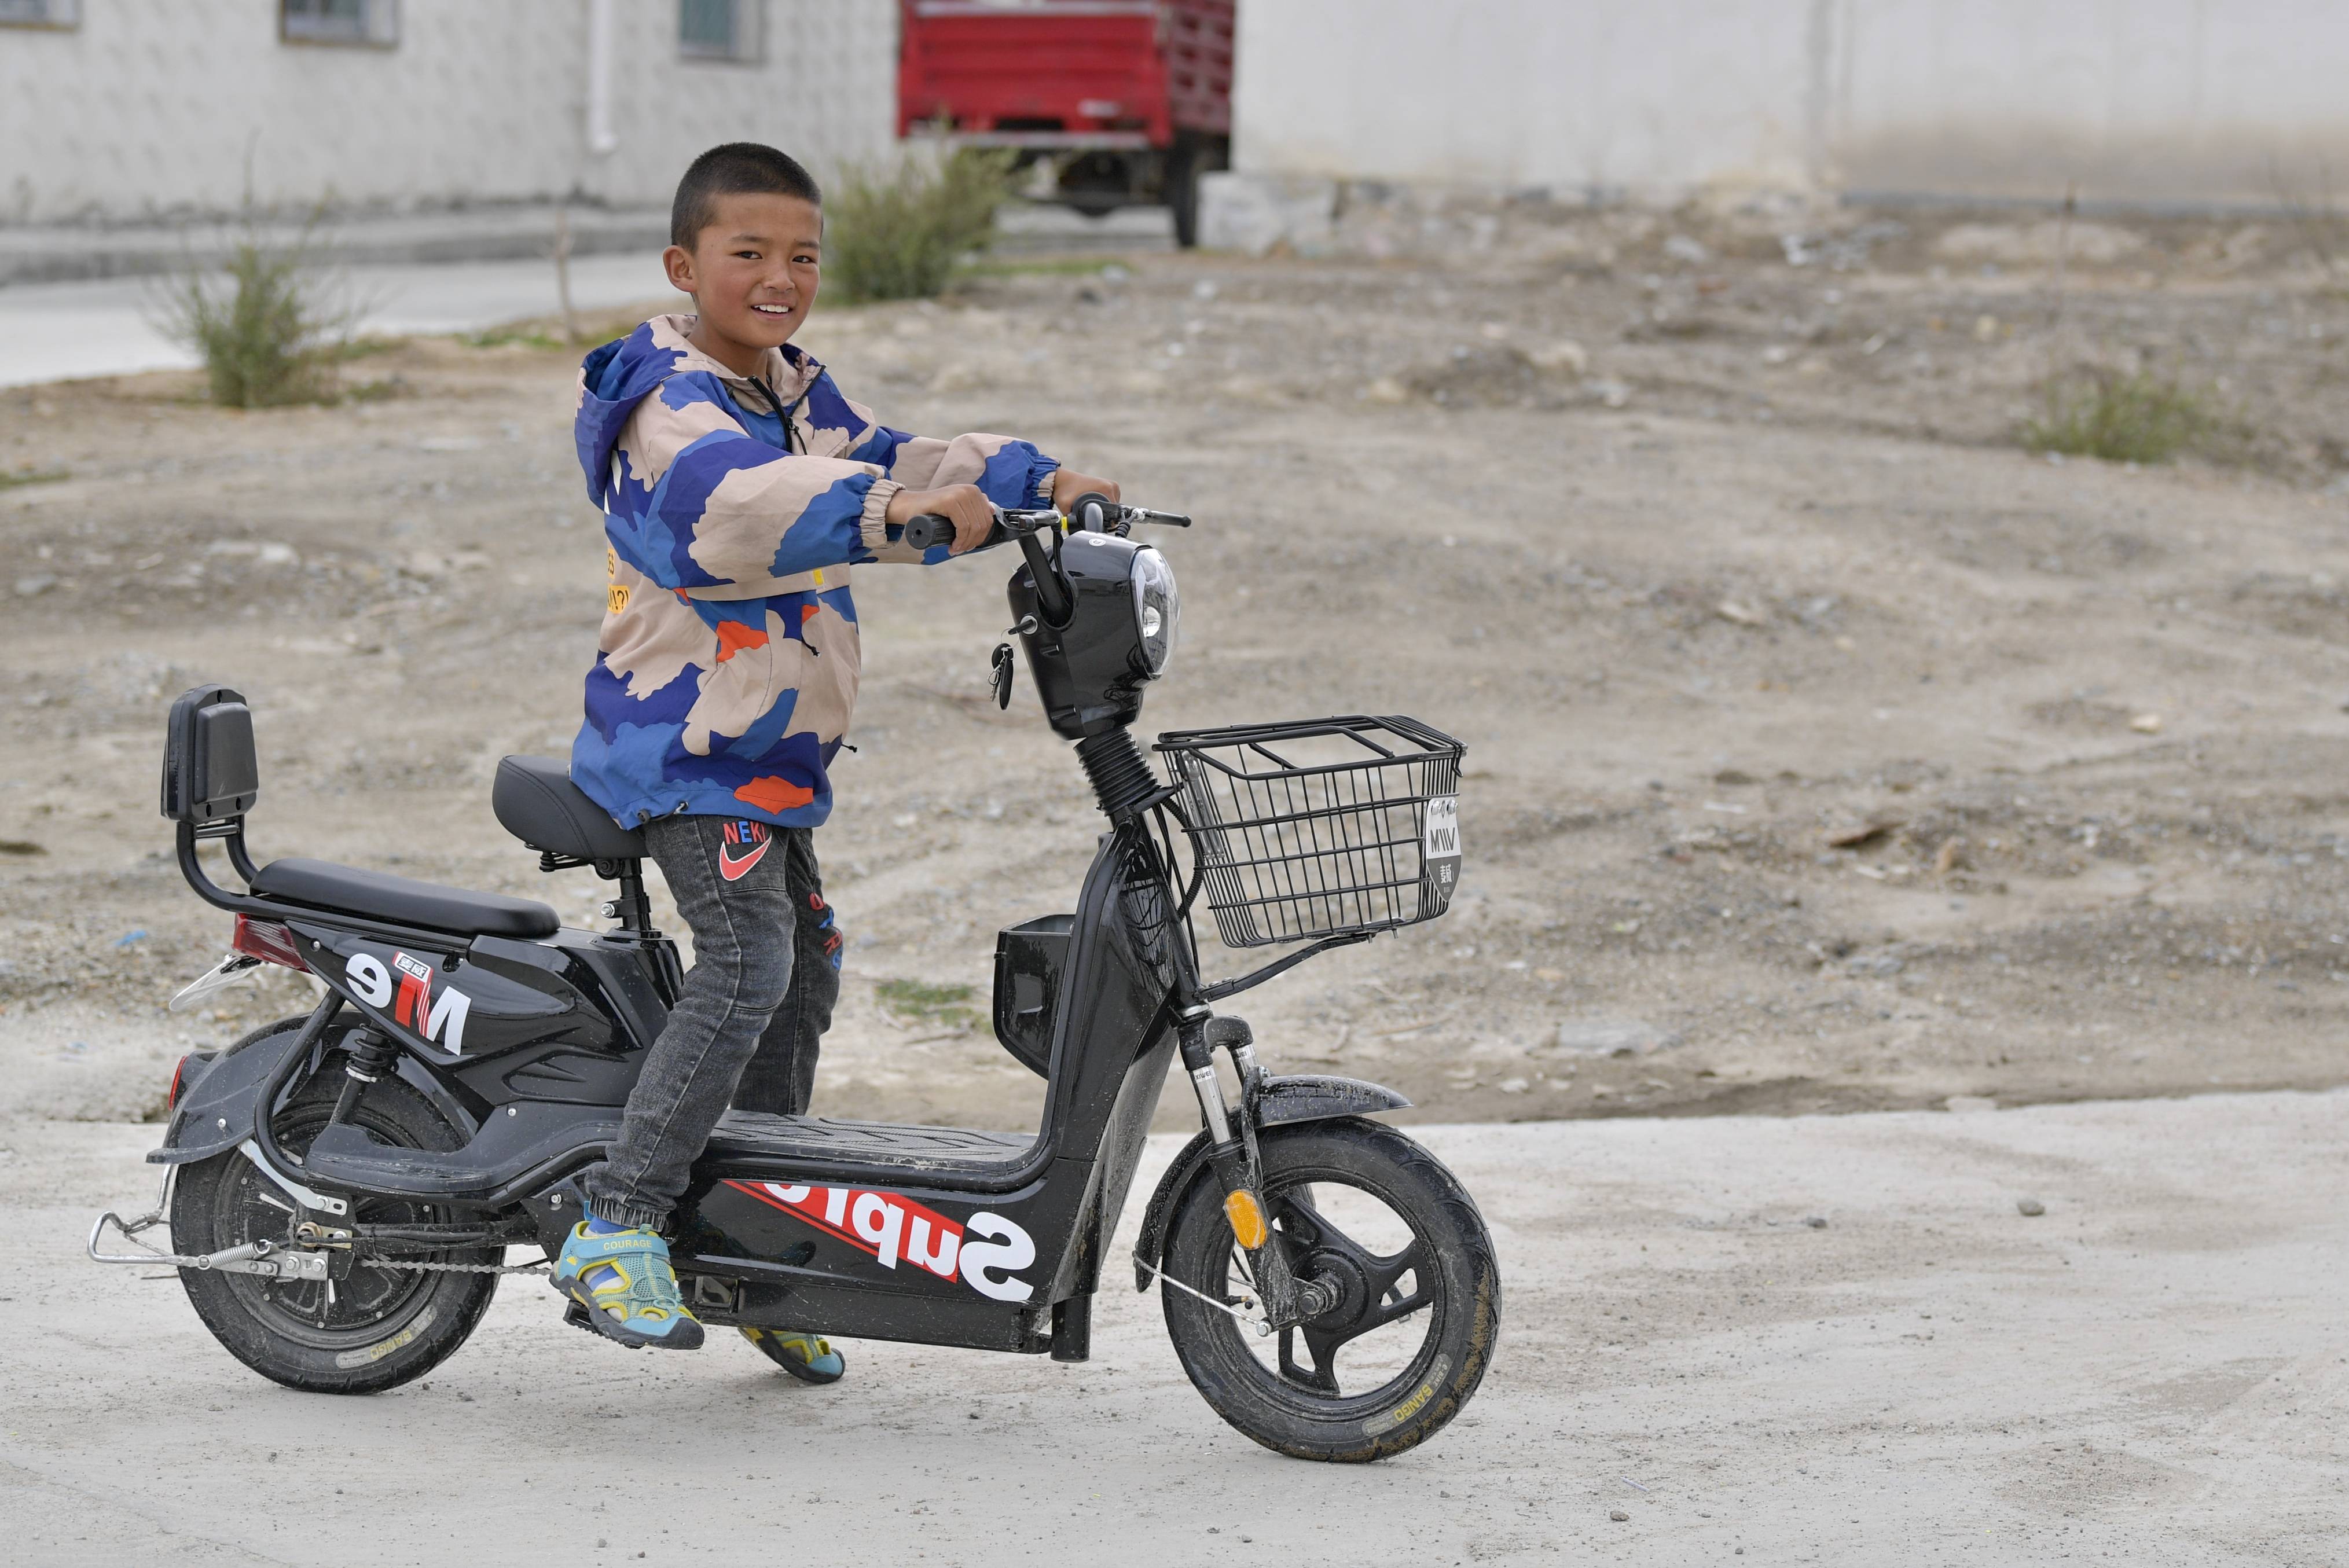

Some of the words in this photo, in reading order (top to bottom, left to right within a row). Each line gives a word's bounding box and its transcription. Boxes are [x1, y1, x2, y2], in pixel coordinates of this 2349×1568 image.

[1195, 1070, 1212, 1080] XIWEI
[603, 1239, 652, 1251] COURAGE
[370, 1330, 413, 1360] SANGO
[1393, 1383, 1433, 1422] SANGO
